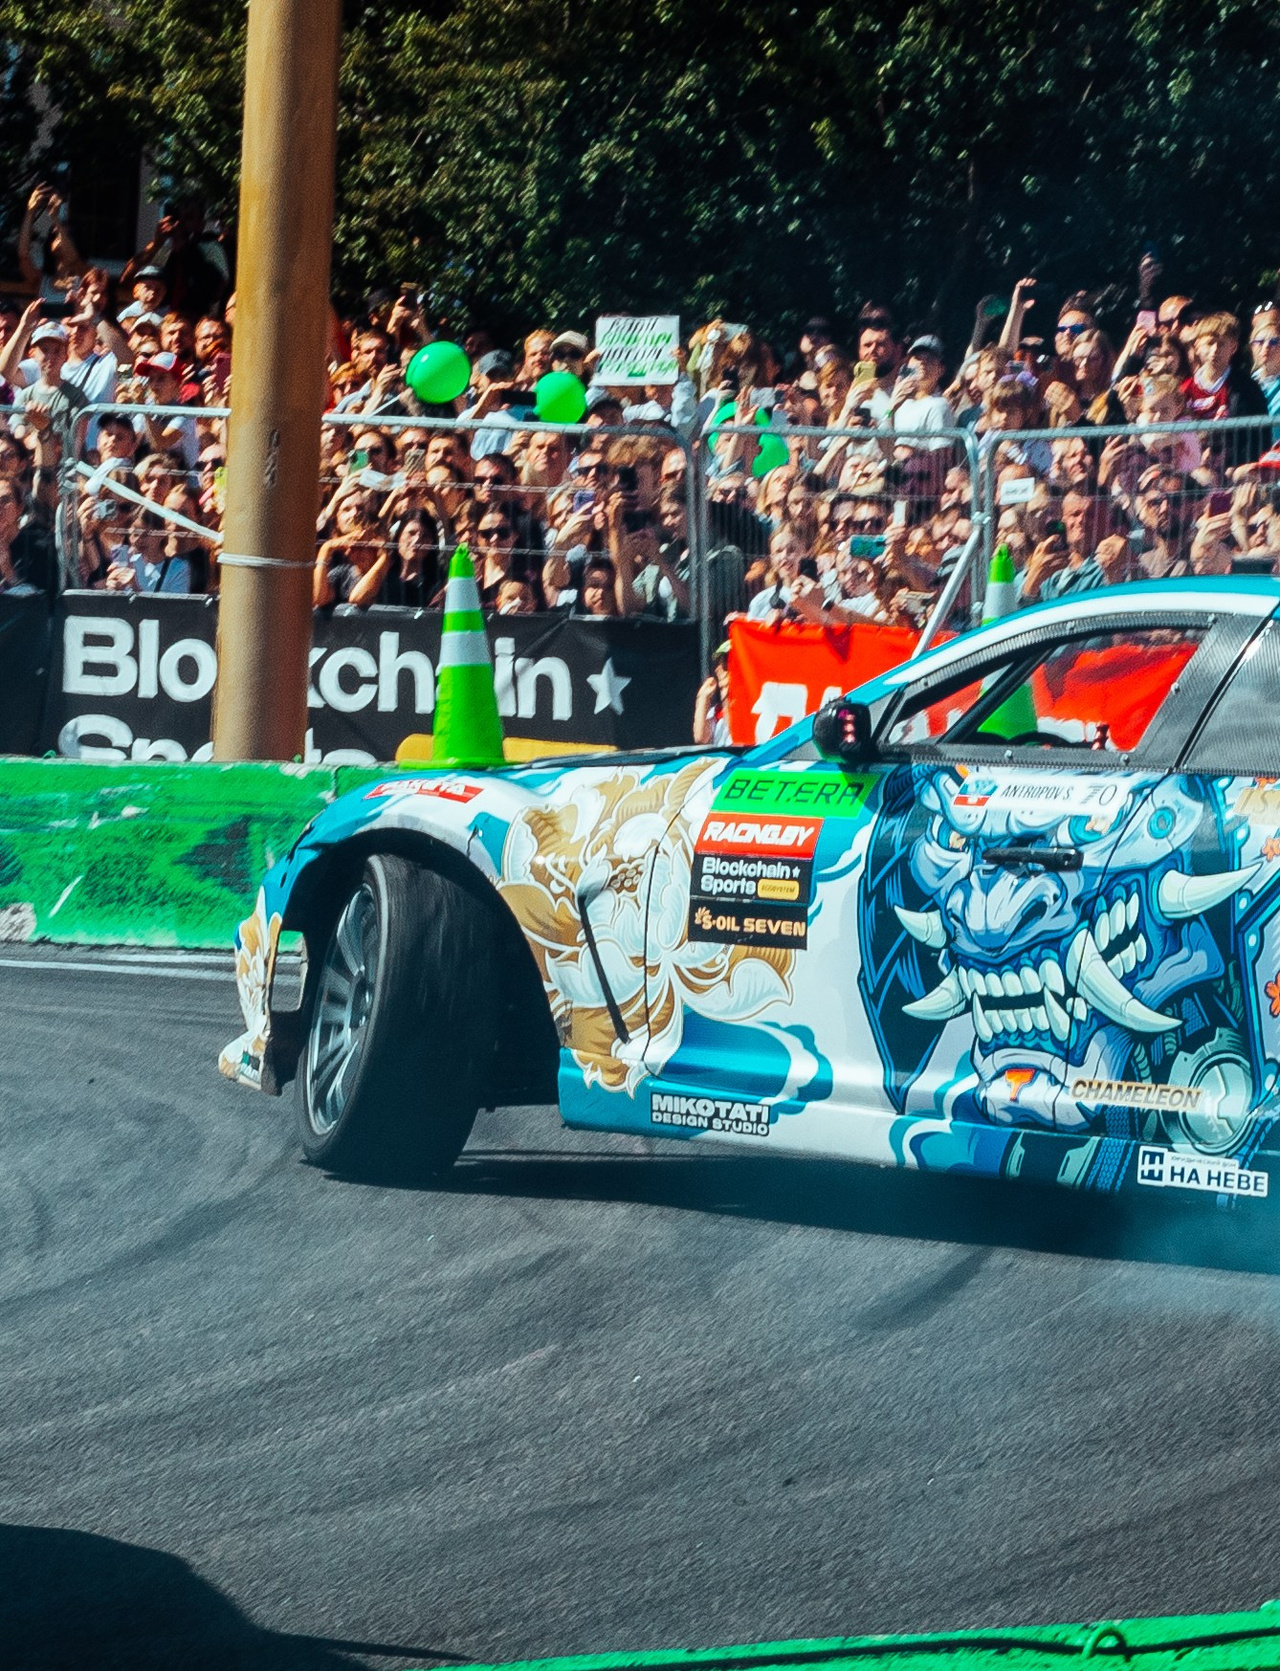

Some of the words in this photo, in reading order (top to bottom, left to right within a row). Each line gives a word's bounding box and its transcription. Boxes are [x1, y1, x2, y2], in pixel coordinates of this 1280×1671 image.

[63, 615, 573, 722] Blochin
[702, 856, 791, 880] Blockchain
[700, 874, 757, 896] Sports
[743, 917, 806, 937] SEVEN
[1071, 1080, 1202, 1108] CHAMELEON
[652, 1094, 769, 1123] MIKOTATI
[652, 1111, 708, 1128] DESIGN
[712, 1117, 768, 1135] STUDIO
